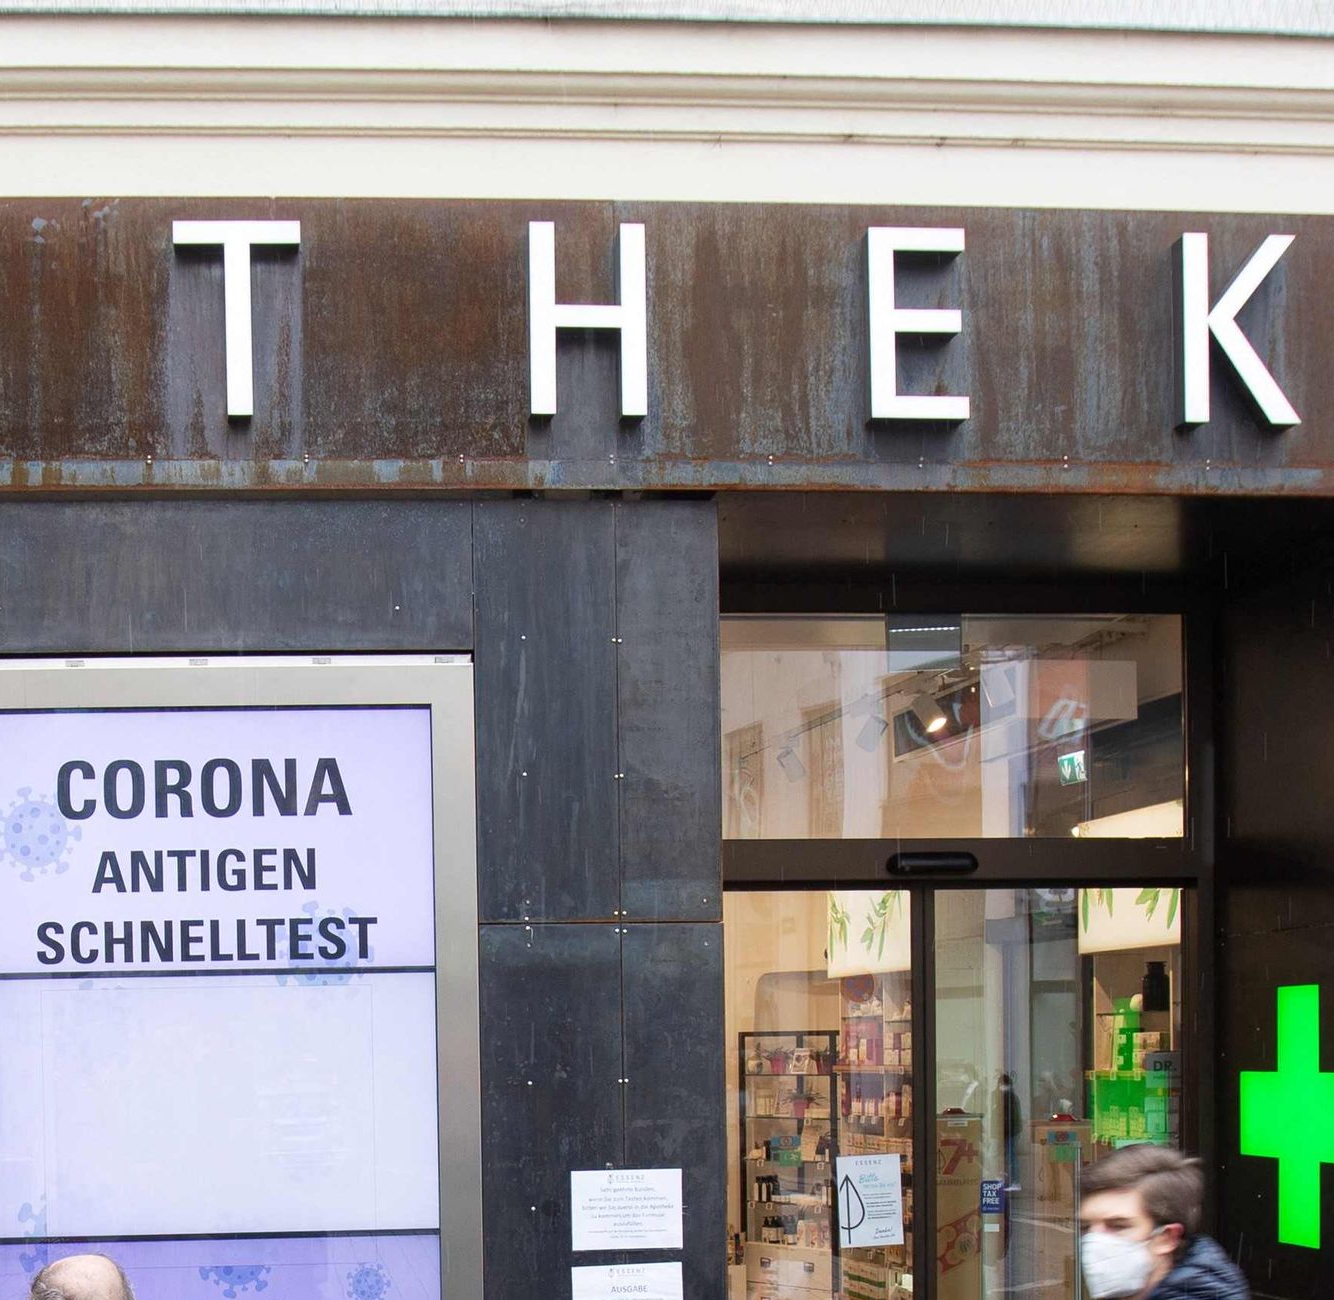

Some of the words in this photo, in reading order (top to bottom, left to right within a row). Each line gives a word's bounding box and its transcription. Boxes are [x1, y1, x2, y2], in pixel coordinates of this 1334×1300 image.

[57, 758, 353, 820] CORONA
[91, 848, 317, 893] ANTIGEN
[36, 917, 378, 965] SCHNELLTEST
[982, 1197, 1000, 1205] FREE
[611, 1284, 648, 1293] AUSGABE
